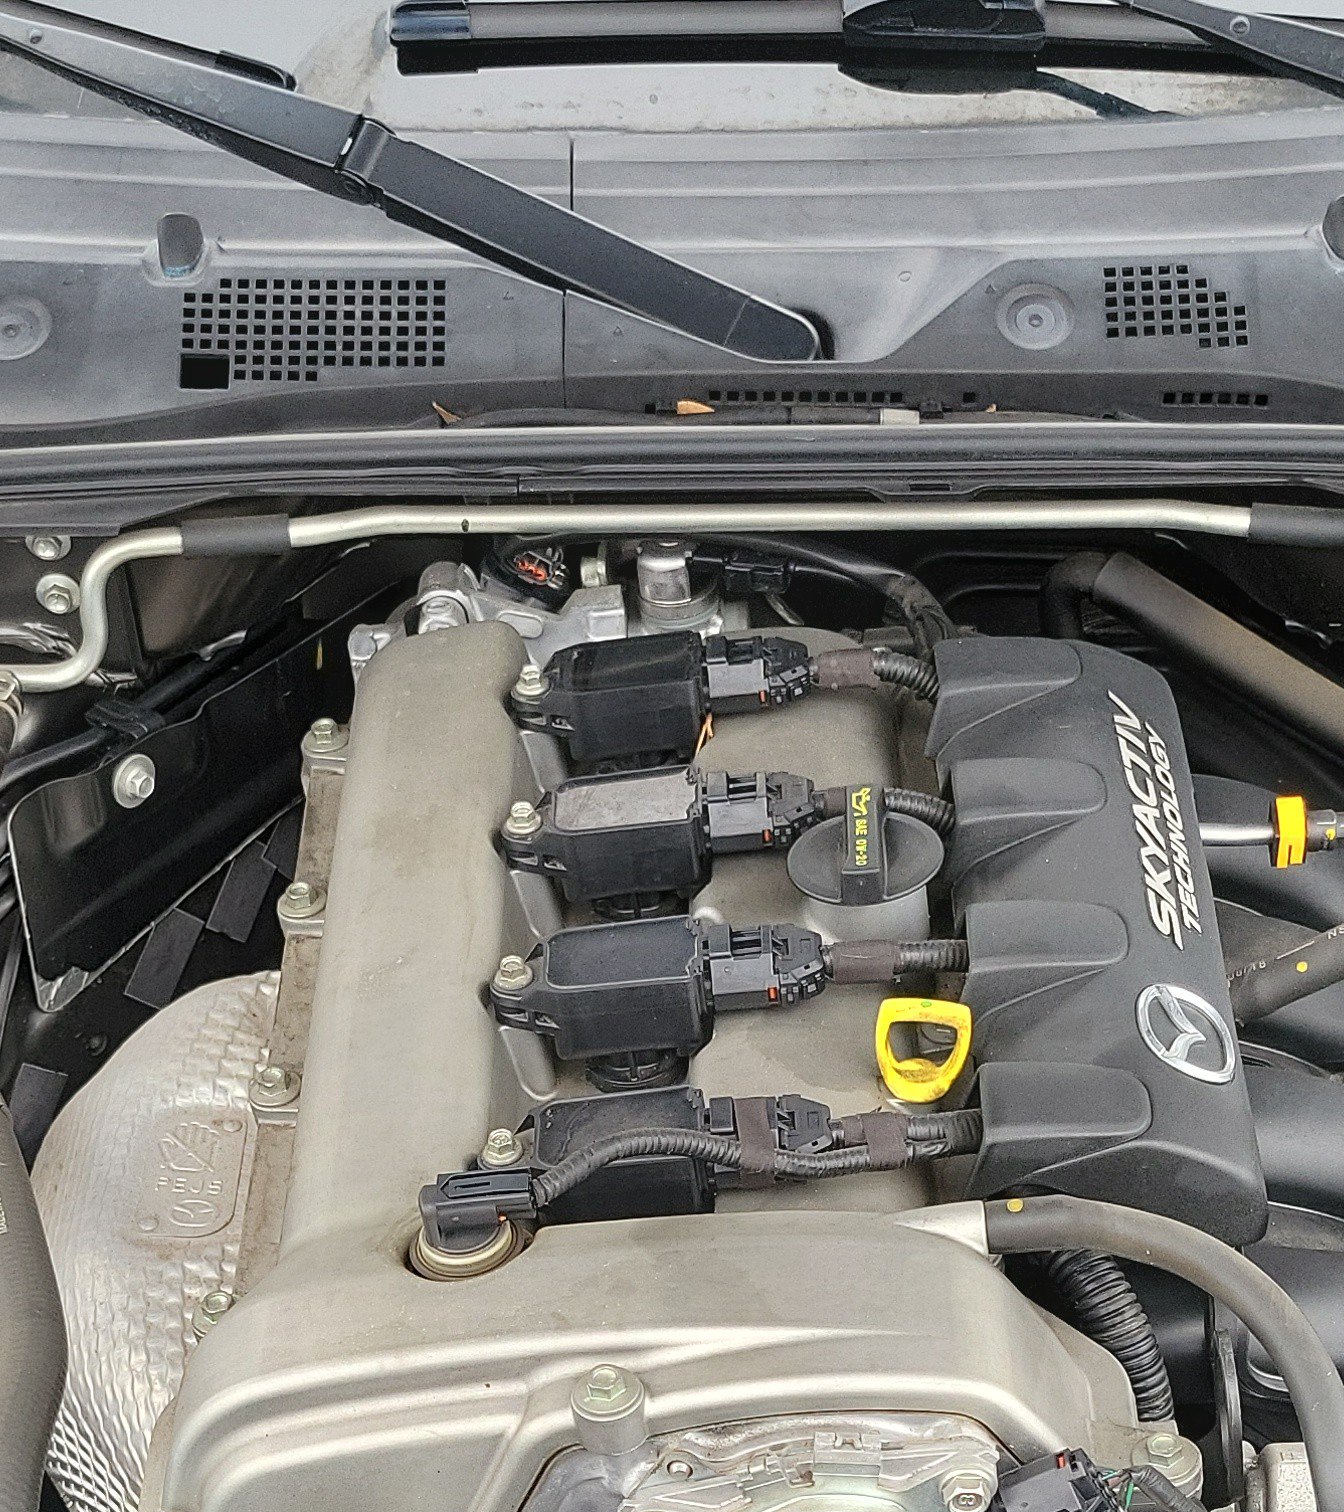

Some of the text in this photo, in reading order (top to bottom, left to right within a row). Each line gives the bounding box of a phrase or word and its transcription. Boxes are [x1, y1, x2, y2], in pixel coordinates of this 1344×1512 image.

[855, 819, 868, 865] SAE 0W-20
[1108, 690, 1185, 950] SKYACTIV
[1144, 724, 1204, 934] TECHNOLOGY
